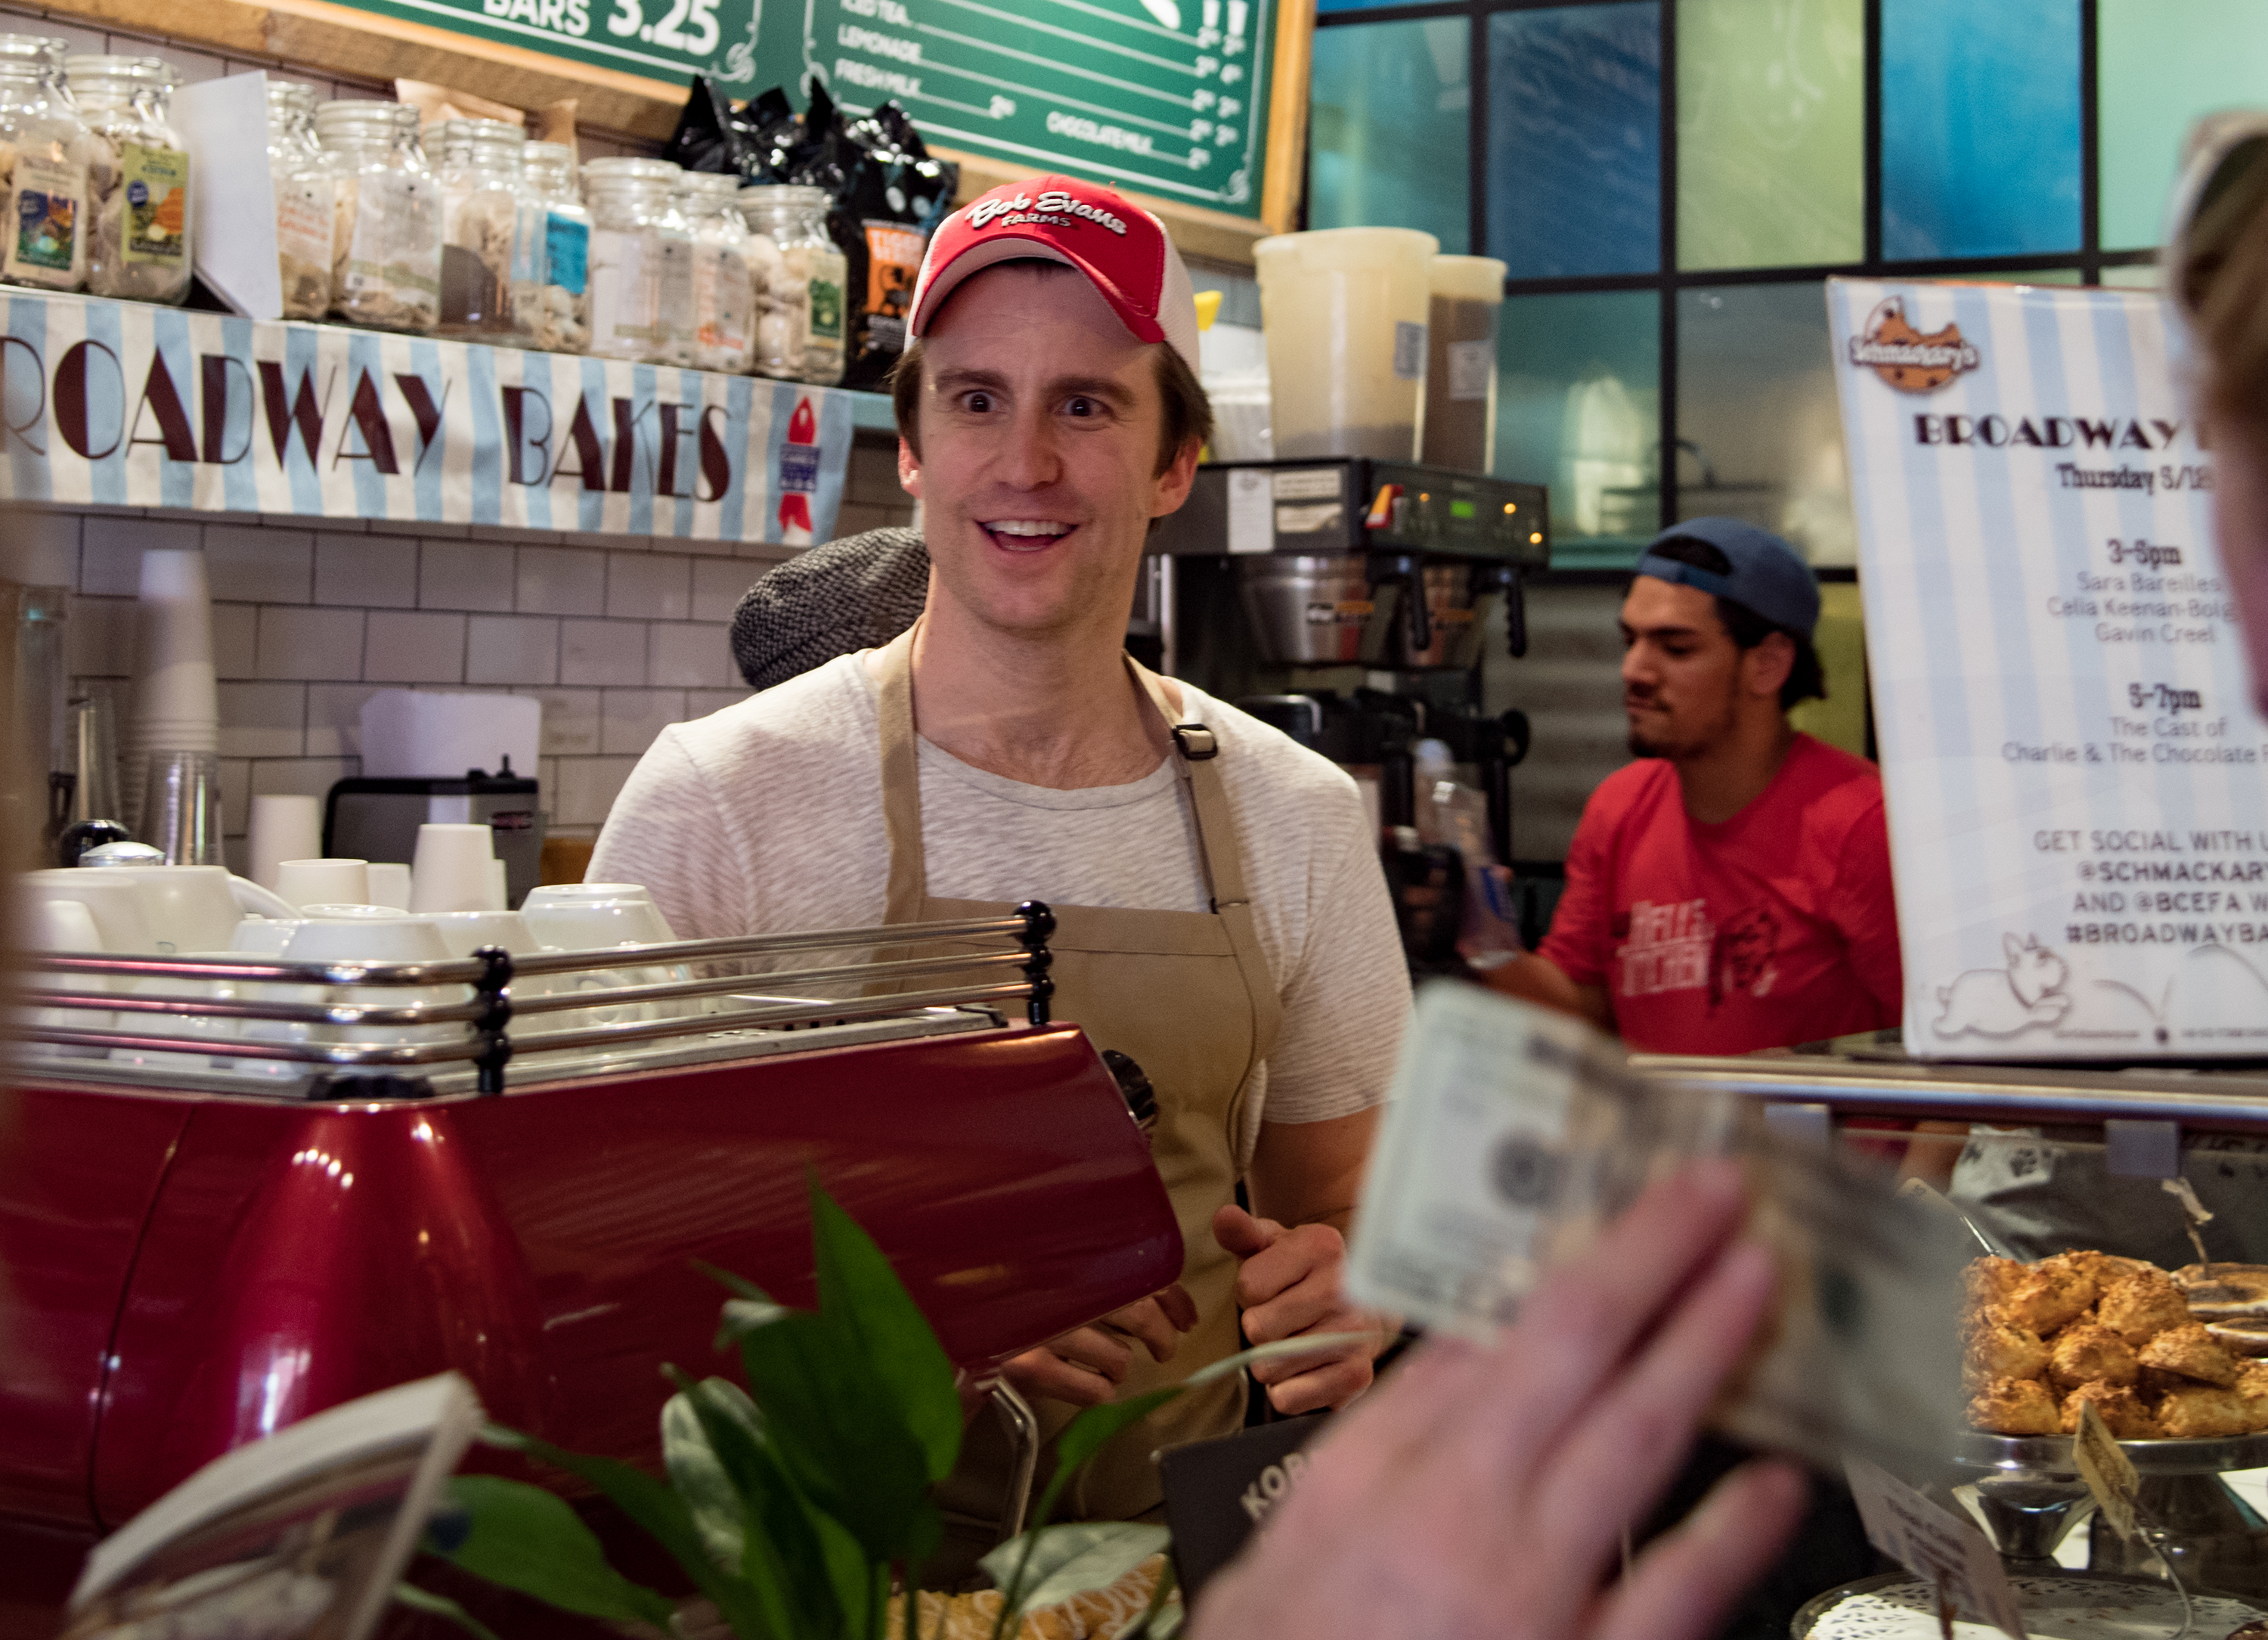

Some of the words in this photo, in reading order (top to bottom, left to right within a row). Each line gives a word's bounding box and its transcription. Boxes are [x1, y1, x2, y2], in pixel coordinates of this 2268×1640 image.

[607, 0, 720, 55] 3.25
[838, 23, 922, 65] LEMONADE
[835, 58, 885, 89] FRESH
[885, 71, 922, 98] MILK
[1046, 111, 1123, 149] CHOCOLATE
[1123, 132, 1154, 153] MILK
[965, 193, 1033, 228] Bob
[1035, 191, 1126, 234] Evans
[1001, 212, 1071, 227] FARMS
[501, 385, 732, 503] BAKES
[1913, 414, 2182, 451] BROADWAY
[2055, 462, 2155, 496] Thursday
[2077, 571, 2125, 592] Sara
[2094, 622, 2155, 642] Gavin
[2159, 623, 2215, 643] Creel
[2109, 717, 2149, 737] The
[2155, 718, 2201, 737] Cast
[2204, 717, 2228, 737] of
[2002, 742, 2077, 762] Charlie
[2084, 742, 2102, 763] &
[2108, 742, 2147, 763] The
[2152, 742, 2257, 764] Chocolate
[2034, 830, 2081, 851] GET
[2090, 830, 2182, 852] SOCIAL
[2189, 831, 2252, 852] WITH
[2077, 860, 2268, 882] @SCHMACKAR
[2073, 891, 2125, 913] AND
[2133, 891, 2242, 913] @BCEFA
